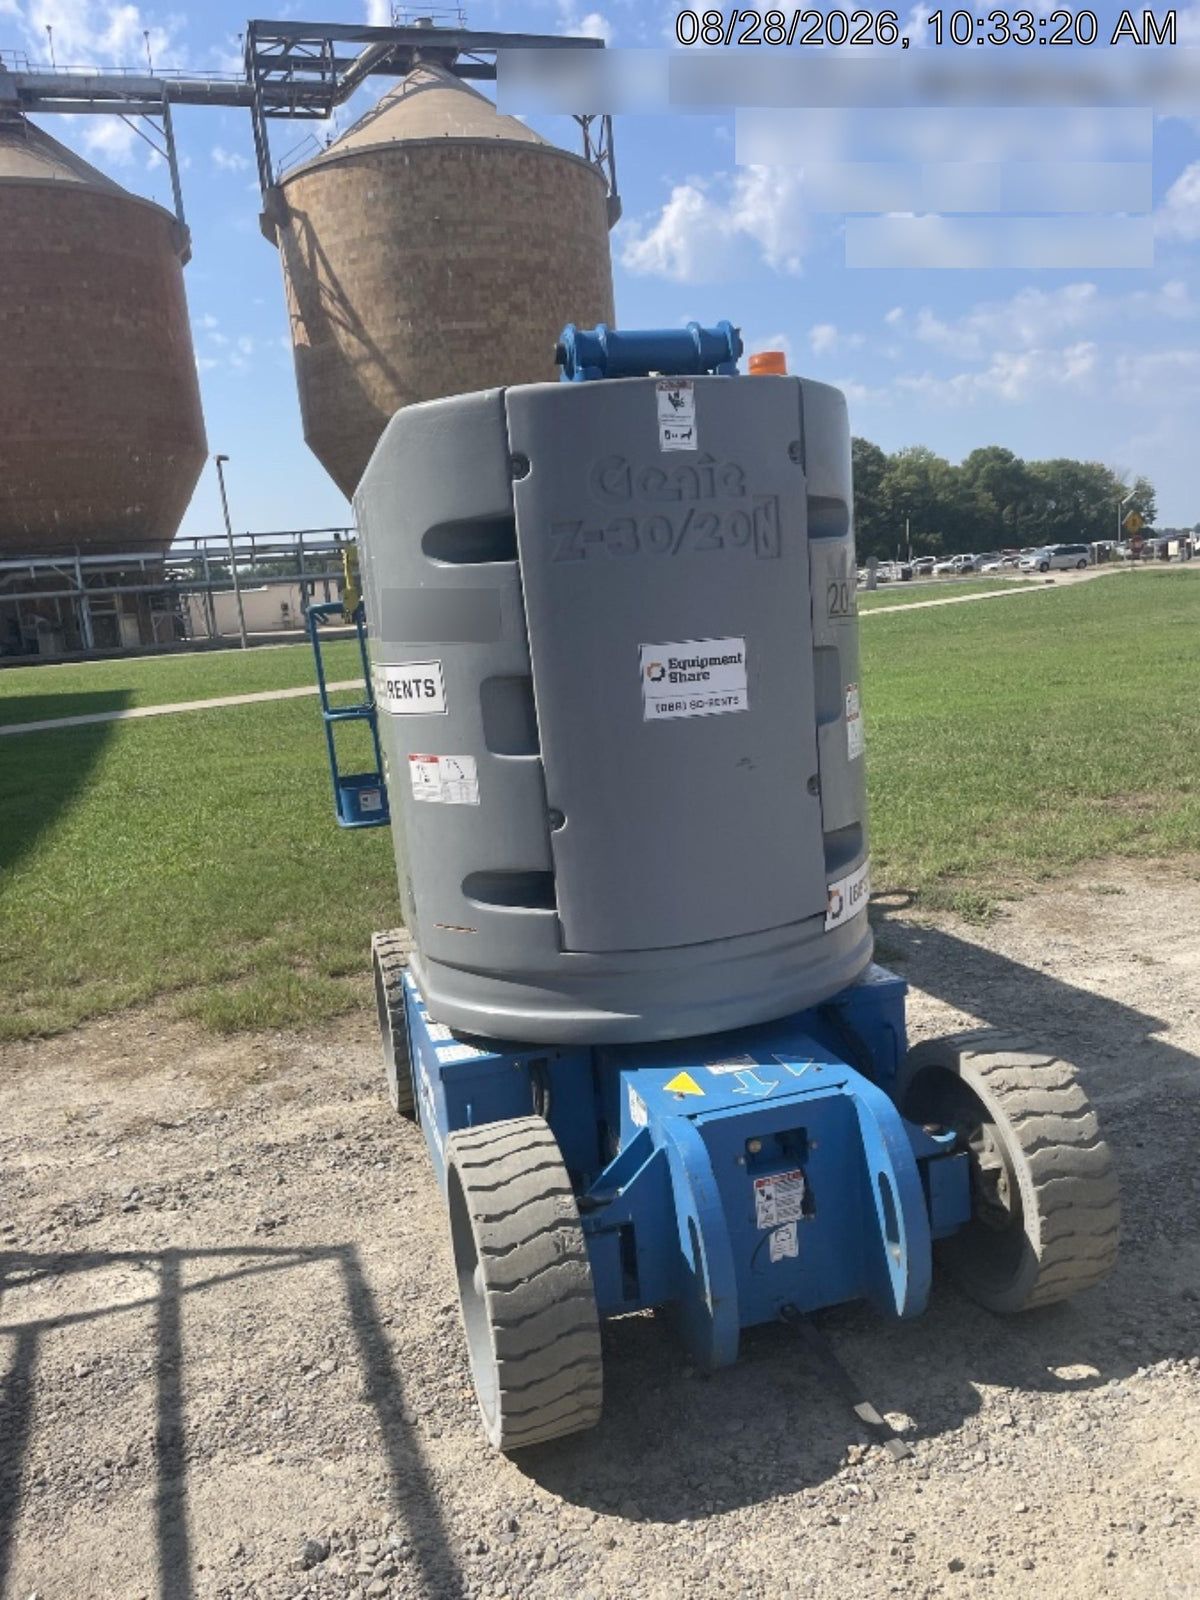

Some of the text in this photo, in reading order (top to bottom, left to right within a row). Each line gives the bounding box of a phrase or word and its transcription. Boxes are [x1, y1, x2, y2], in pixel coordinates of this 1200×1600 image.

[589, 453, 746, 501] Genie
[552, 494, 780, 563] Z-30/20N
[668, 652, 742, 670] Equipment
[668, 671, 710, 683] Share
